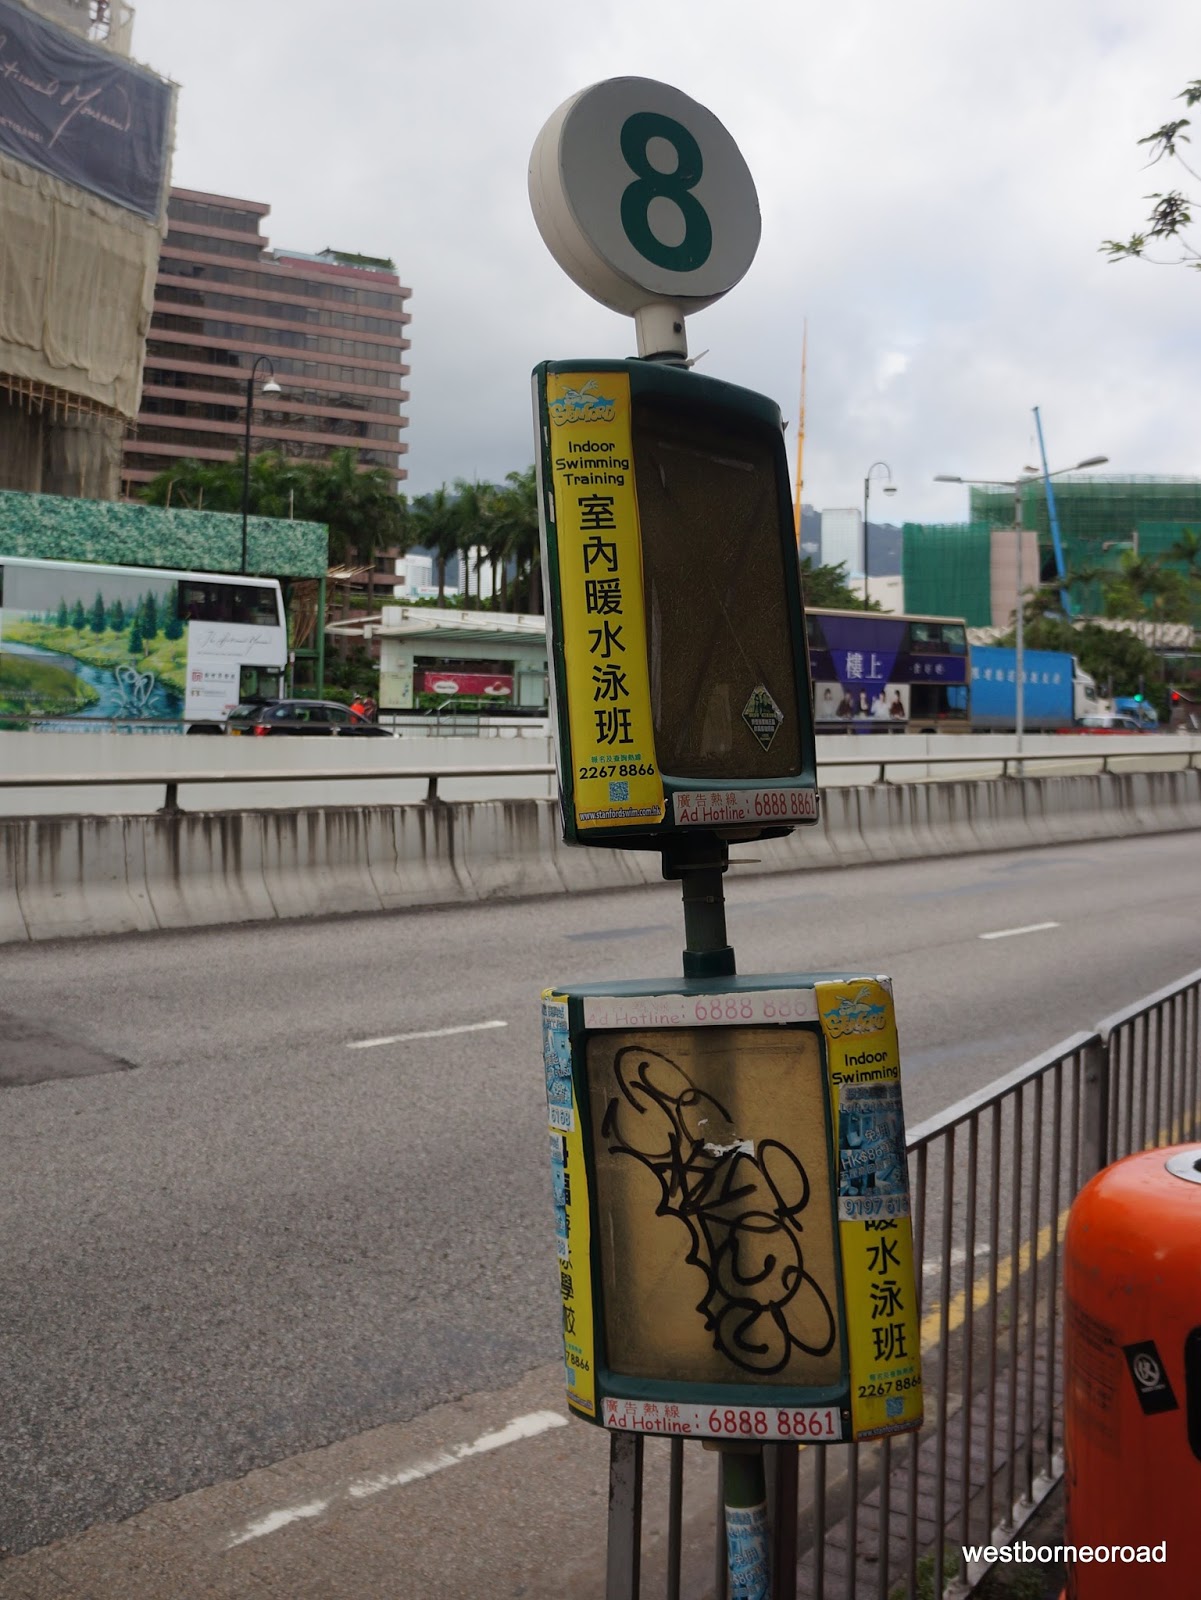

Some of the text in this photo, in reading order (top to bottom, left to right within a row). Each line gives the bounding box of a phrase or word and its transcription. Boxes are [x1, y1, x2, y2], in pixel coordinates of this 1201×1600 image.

[620, 111, 713, 273] 8
[568, 440, 615, 453] Indoor
[555, 456, 629, 471] Swimming
[563, 472, 625, 486] Training
[577, 493, 634, 745] 室內暖水泳班
[579, 763, 655, 780] 2267 8866
[677, 792, 738, 808] 廣告熱線
[680, 808, 698, 822] Ad
[754, 793, 787, 816] 6888
[790, 792, 815, 815] 8861
[579, 806, 661, 821] www.stanfordswim.com.hk
[587, 1012, 608, 1025] Ad
[694, 999, 753, 1022] 6888
[844, 1052, 888, 1067] Indoor
[832, 1066, 898, 1085] Swimming
[844, 1198, 883, 1216] 9197
[570, 1354, 590, 1372] 8866
[858, 1382, 892, 1398] 2267
[606, 1400, 680, 1418] 廣告熱線
[608, 1414, 627, 1428] Ad
[708, 1408, 768, 1435] 6888
[777, 1409, 835, 1436] 8861
